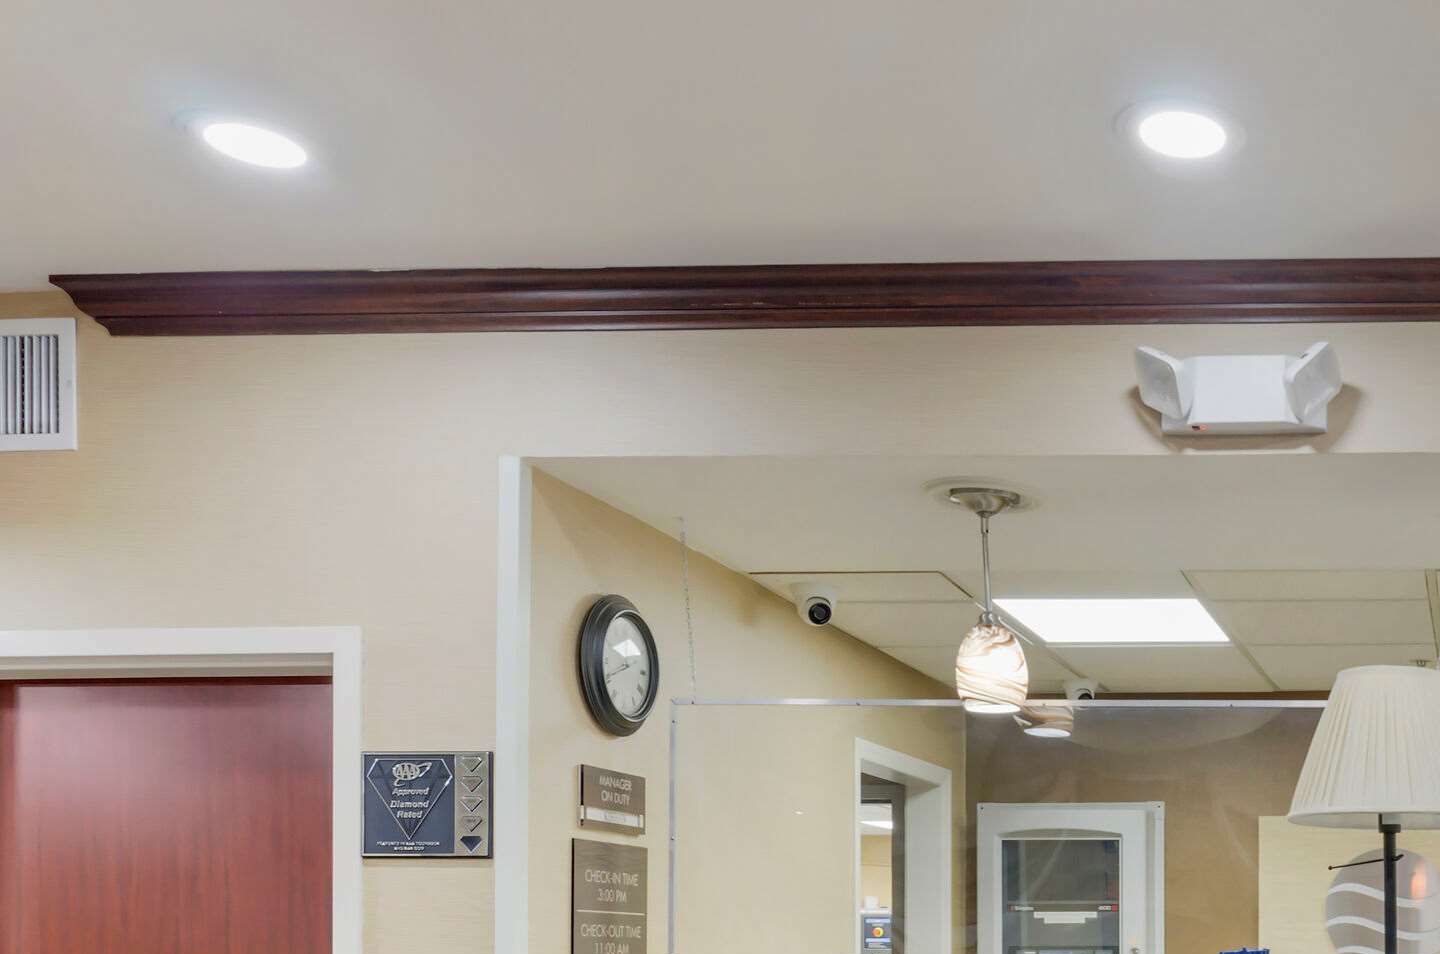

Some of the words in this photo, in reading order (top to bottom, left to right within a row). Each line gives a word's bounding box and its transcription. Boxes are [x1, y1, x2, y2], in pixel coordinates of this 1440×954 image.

[599, 775, 632, 791] MANAGER
[392, 787, 430, 796] Approved
[601, 790, 613, 801] ON
[614, 793, 630, 805] DUTY
[390, 800, 430, 808] Diamond
[396, 810, 423, 819] Rated
[584, 869, 621, 884] CHECK-IN
[622, 872, 639, 886] TIME
[597, 888, 614, 902] 3:00
[615, 889, 627, 903] PM
[625, 925, 642, 938] TIME
